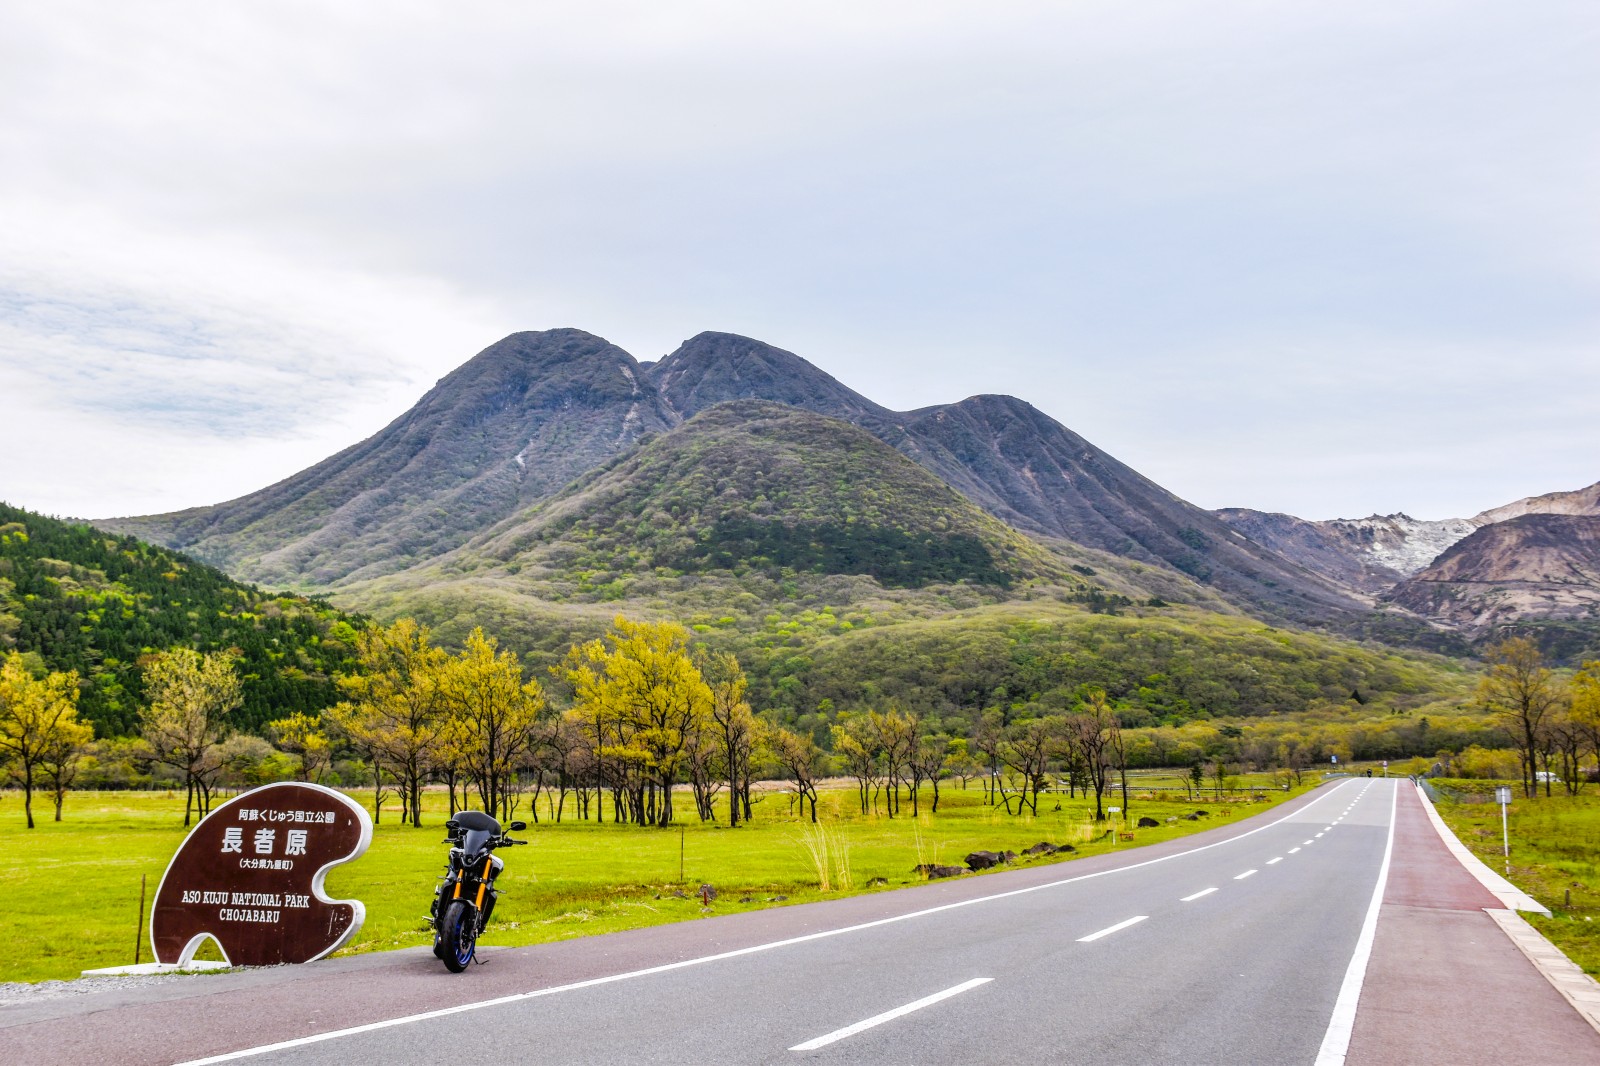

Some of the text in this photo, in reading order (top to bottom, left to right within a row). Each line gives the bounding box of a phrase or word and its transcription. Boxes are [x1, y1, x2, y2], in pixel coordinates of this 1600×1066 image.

[238, 808, 336, 824] 阿蘇くじゅう国立公園
[220, 827, 308, 856] 長者原
[181, 890, 310, 909] ASO KUJU NATIONAL PARK
[219, 908, 280, 924] CHOJABARU
